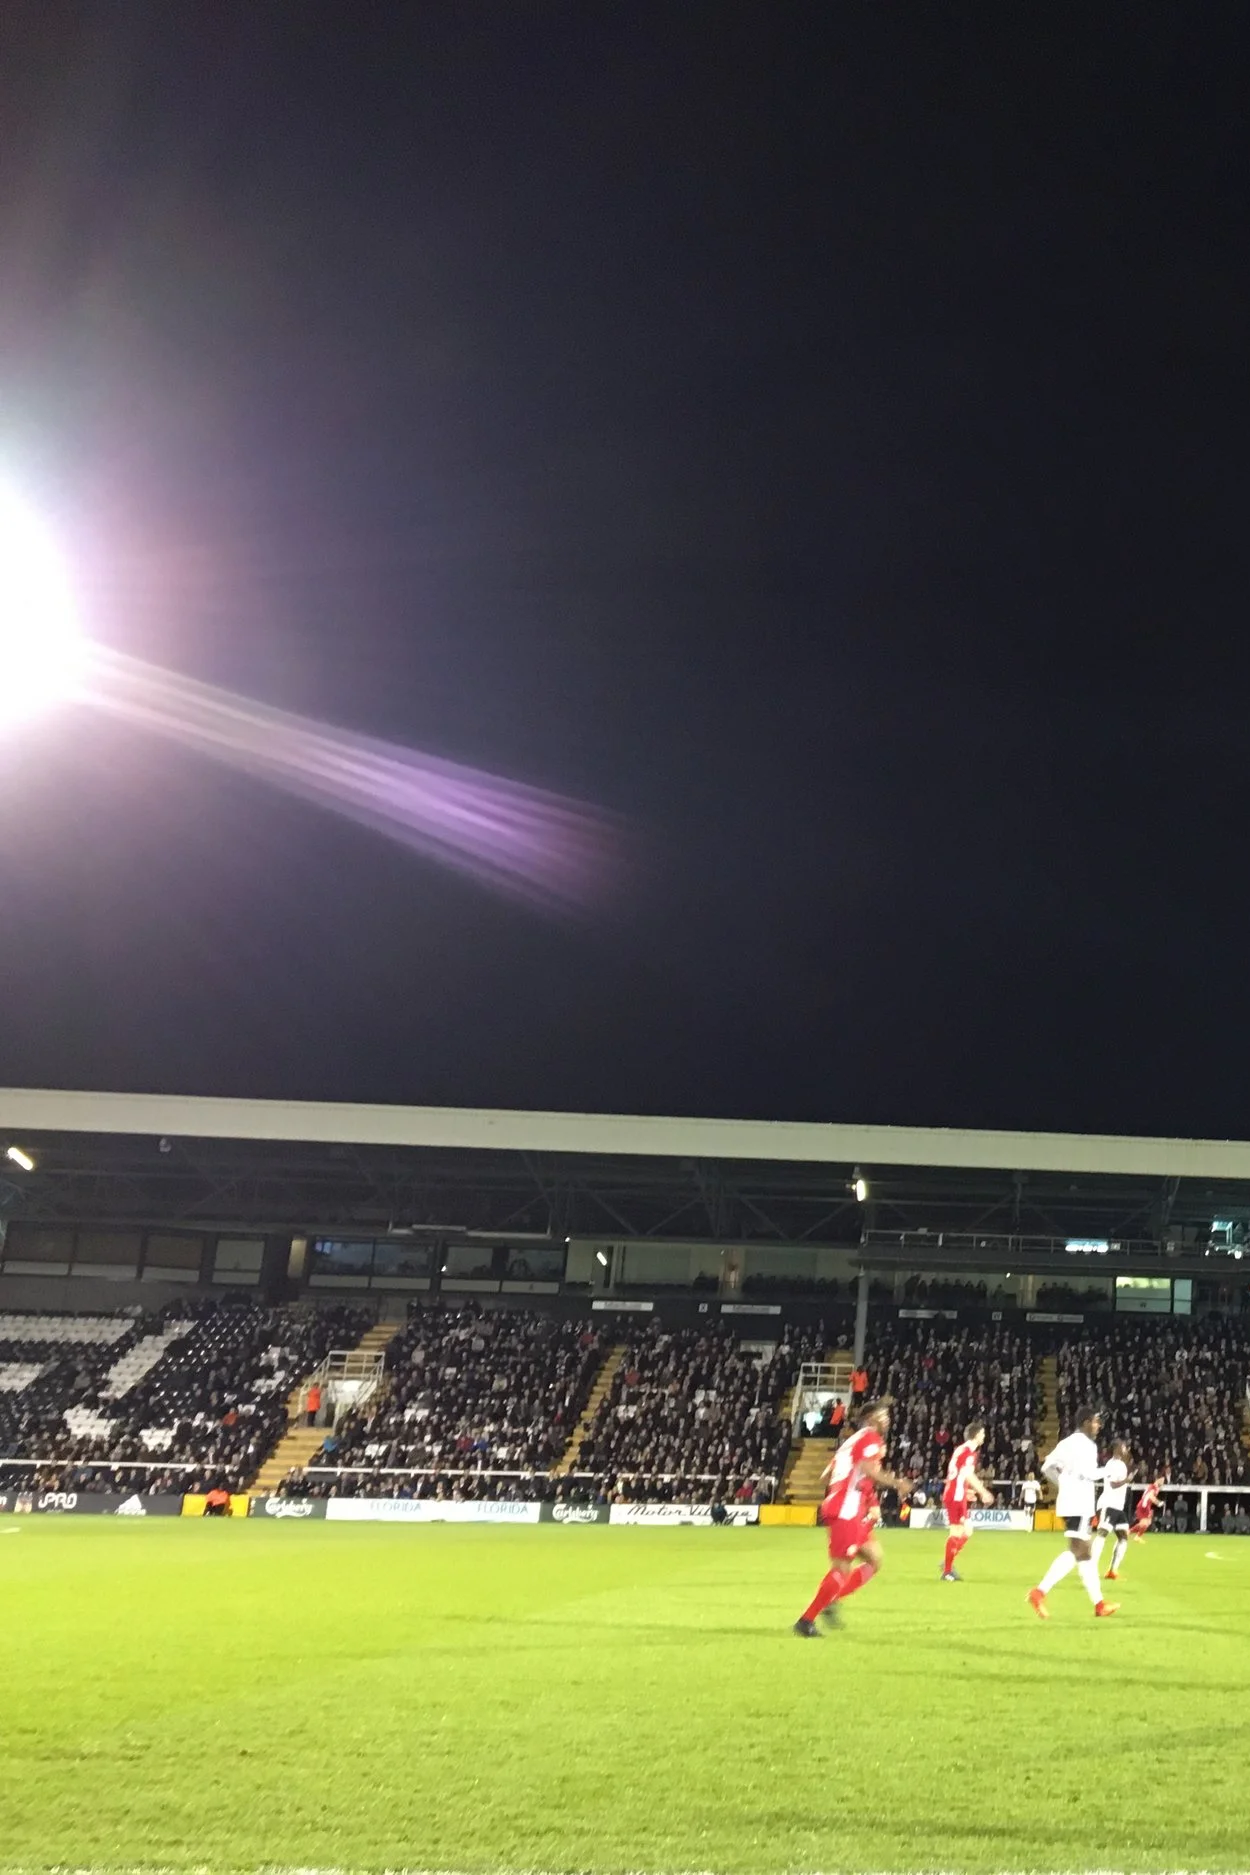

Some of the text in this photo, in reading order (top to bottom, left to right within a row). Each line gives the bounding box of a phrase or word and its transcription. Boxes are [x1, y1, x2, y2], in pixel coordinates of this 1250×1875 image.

[265, 1497, 314, 1516] Carlsberg
[477, 1502, 529, 1514] FLORIDA
[552, 1503, 600, 1521] Carlsberg
[627, 1502, 686, 1516] Motor
